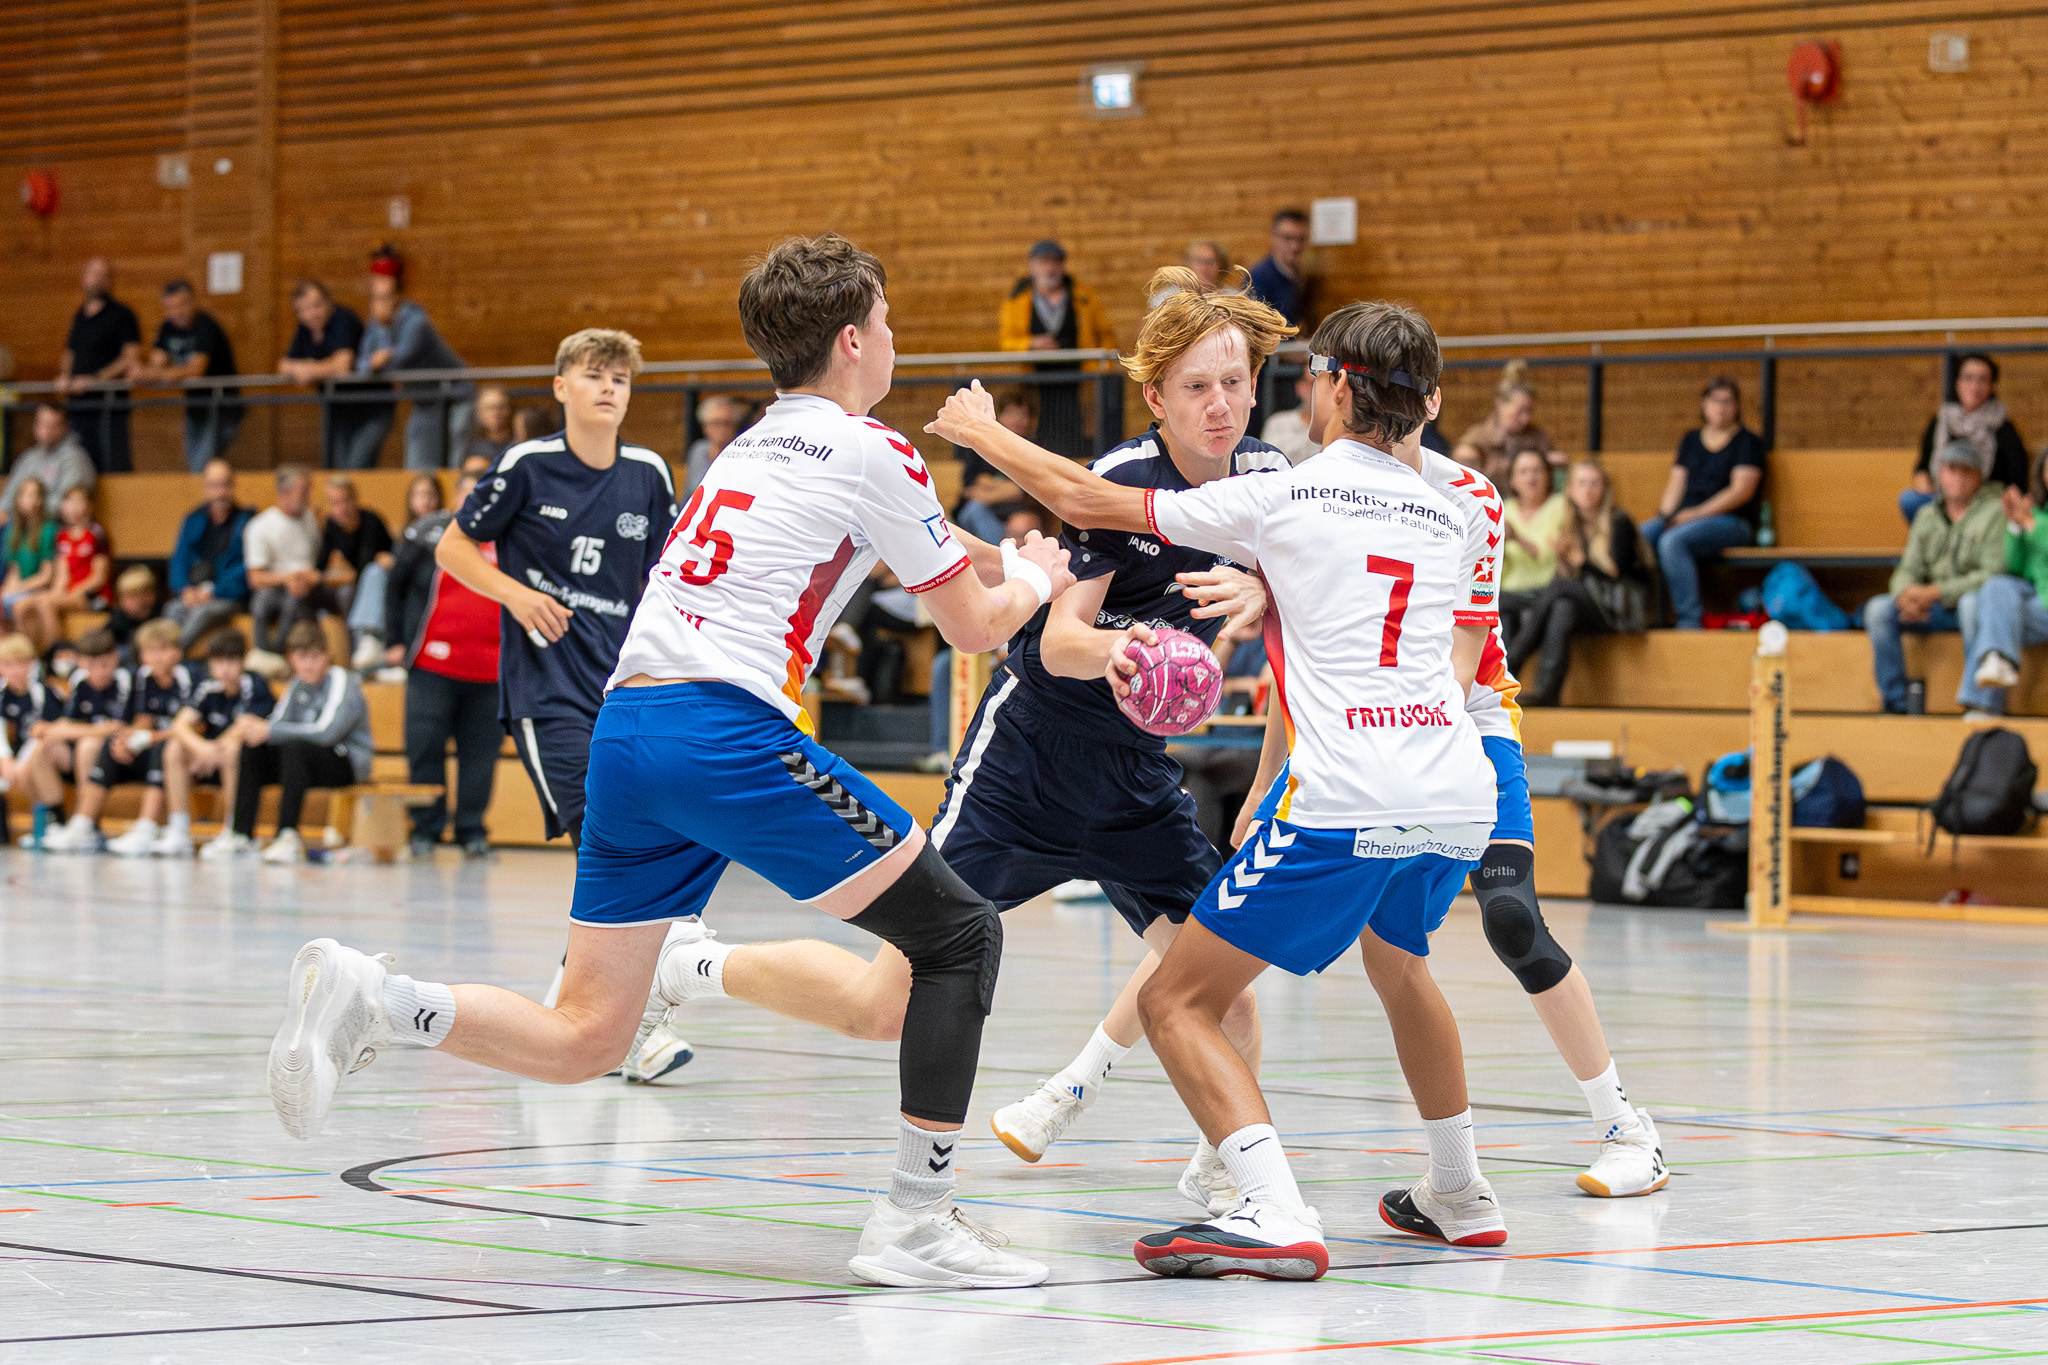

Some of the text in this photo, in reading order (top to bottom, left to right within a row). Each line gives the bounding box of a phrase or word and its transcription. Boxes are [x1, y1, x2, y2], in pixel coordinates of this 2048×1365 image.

[757, 435, 834, 462] Handball
[570, 535, 605, 576] 15
[1128, 535, 1160, 556] JAKO
[1366, 554, 1414, 667] 7
[1483, 865, 1516, 878] Gritin
